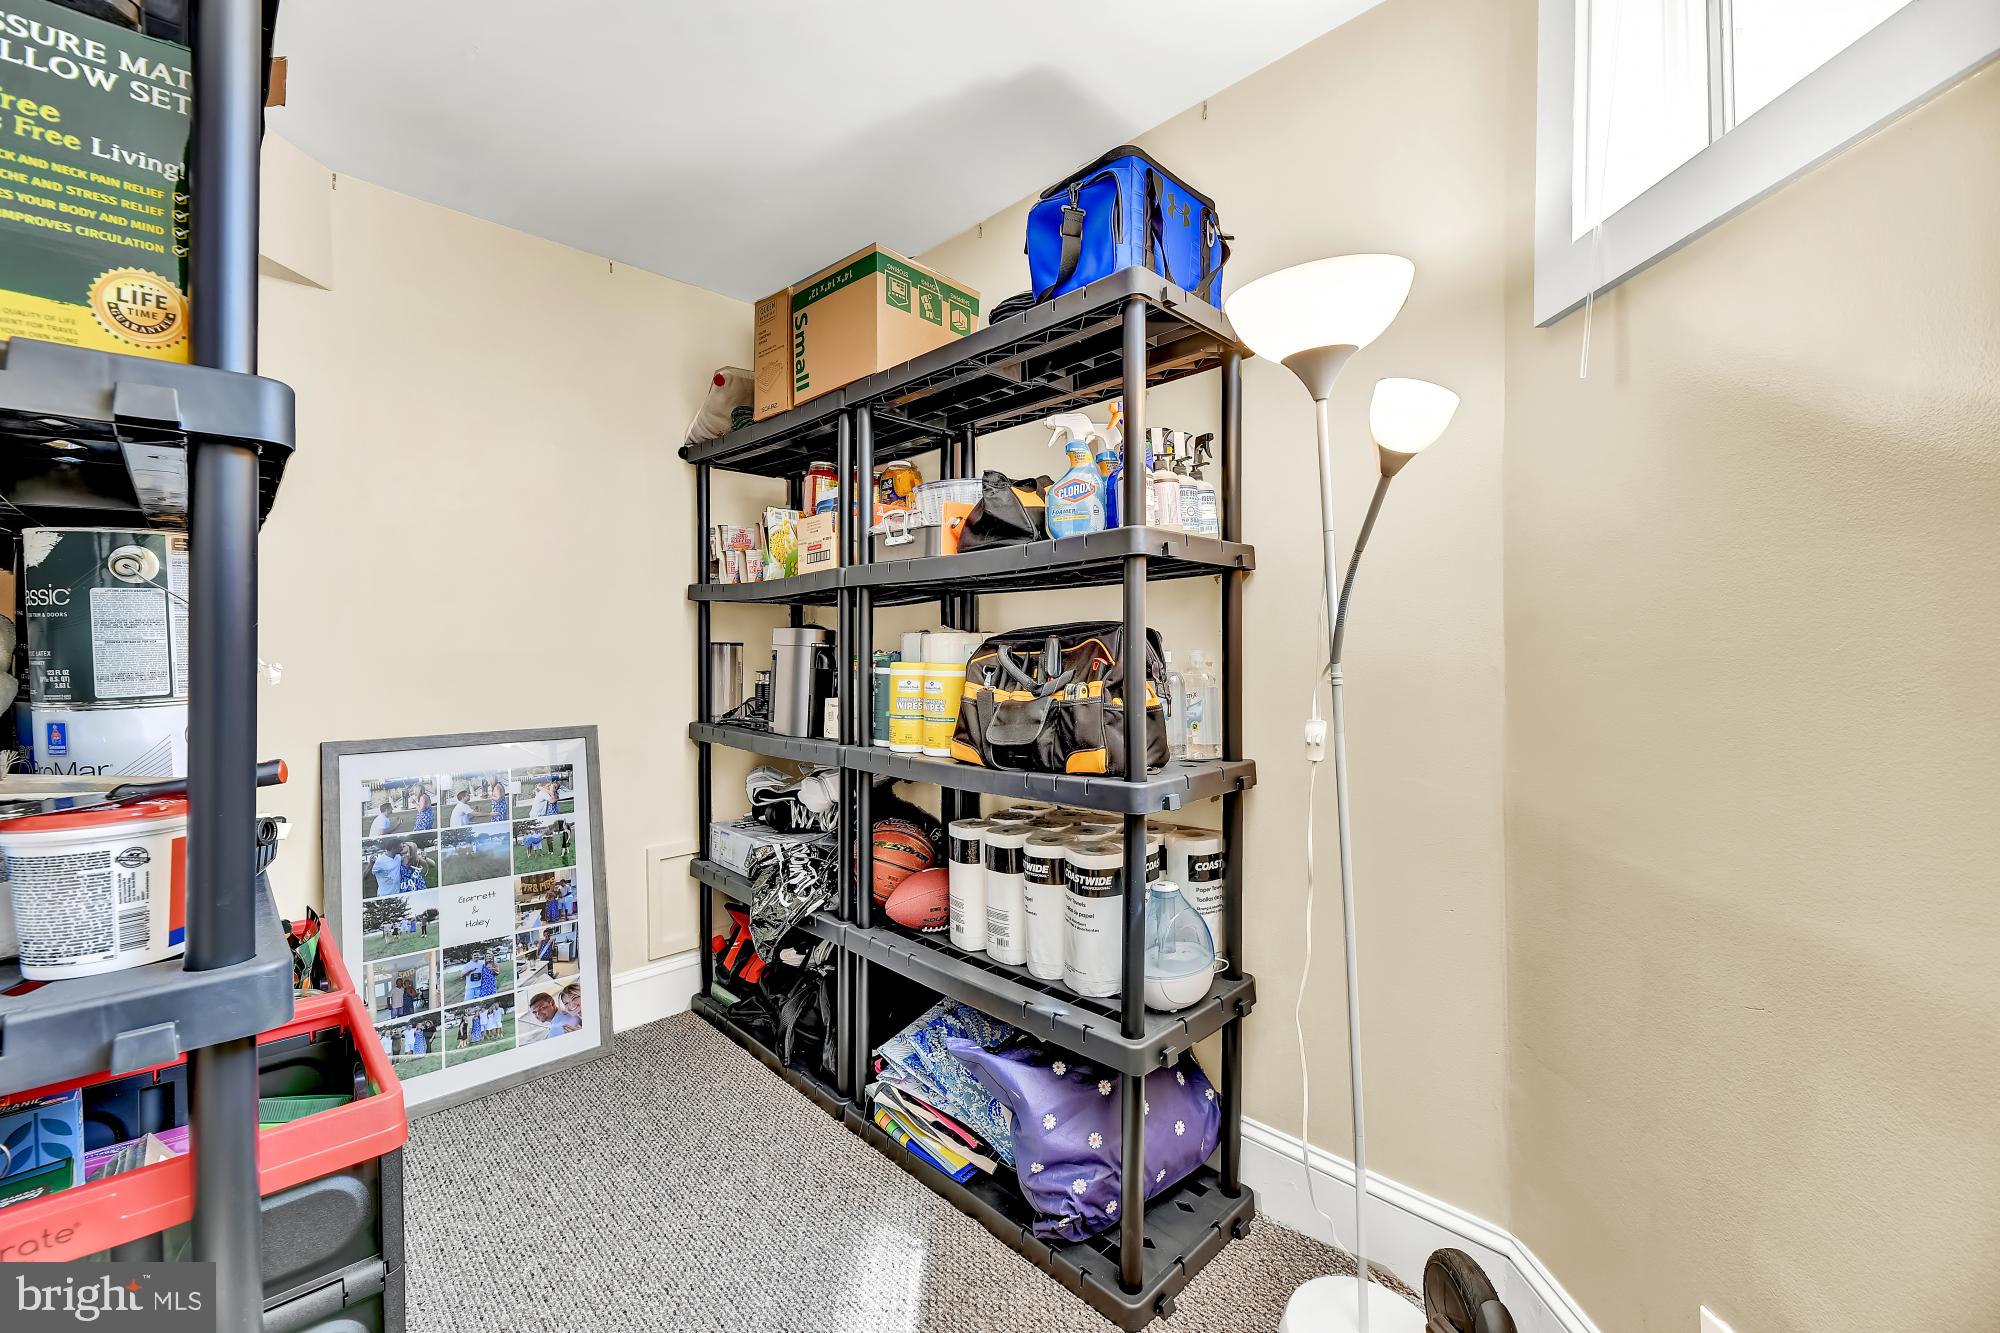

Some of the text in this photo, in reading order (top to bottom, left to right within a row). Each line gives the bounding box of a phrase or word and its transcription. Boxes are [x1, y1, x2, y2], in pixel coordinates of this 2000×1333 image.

[0, 10, 191, 90] SURE MAT
[0, 85, 61, 122] ree
[129, 80, 191, 115] SET
[14, 114, 185, 181] Free Living!
[17, 154, 50, 170] AND
[51, 162, 89, 180] NECK
[90, 172, 120, 189] PAIN
[123, 181, 165, 200] RELIEF
[31, 176, 64, 193] AND
[65, 185, 118, 206] STRESS
[121, 198, 165, 217] RELIEF
[15, 191, 57, 210] YOUR
[58, 202, 97, 219] BODY
[99, 212, 128, 227] AND
[130, 219, 165, 236] MIND
[75, 225, 165, 254] CIRCULATION
[116, 287, 168, 311] LIFE
[2, 306, 42, 319] QUALITY
[127, 307, 159, 321] TIME
[47, 324, 79, 336] TRAVEL
[795, 312, 810, 392] Small
[1058, 482, 1091, 499] CLOROX
[896, 701, 923, 710] WIPES
[1065, 867, 1113, 886] COASTWIDE
[458, 890, 496, 904] Garrett
[472, 905, 480, 914] &
[1078, 912, 1095, 920] papel
[465, 919, 490, 928] Haley
